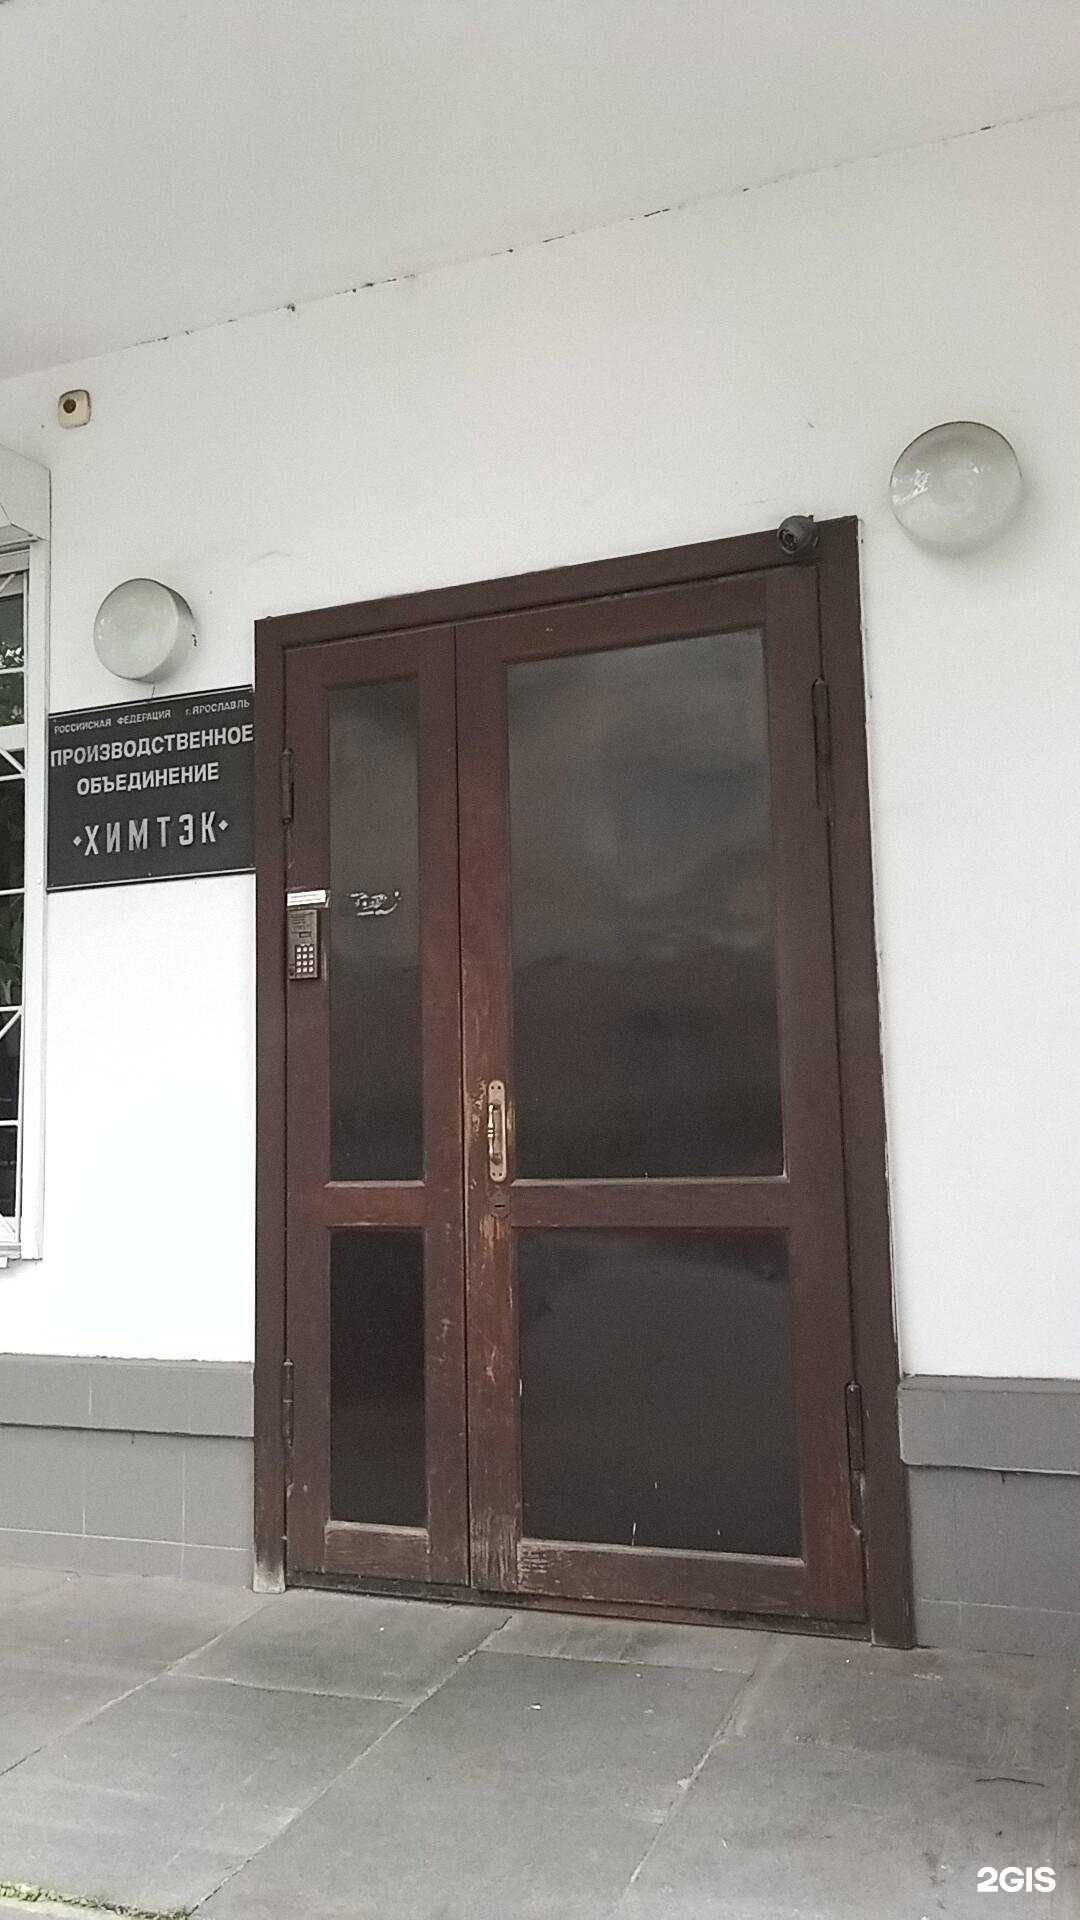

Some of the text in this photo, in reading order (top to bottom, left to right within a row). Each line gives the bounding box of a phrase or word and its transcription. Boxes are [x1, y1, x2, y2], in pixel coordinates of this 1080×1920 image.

[116, 708, 172, 725] ФЕДЕРАЦИЯ
[50, 724, 254, 768] ПРОИЗВОДСТВЕННОЕ
[76, 762, 220, 796] ОБЪЕДИНЕНИЕ
